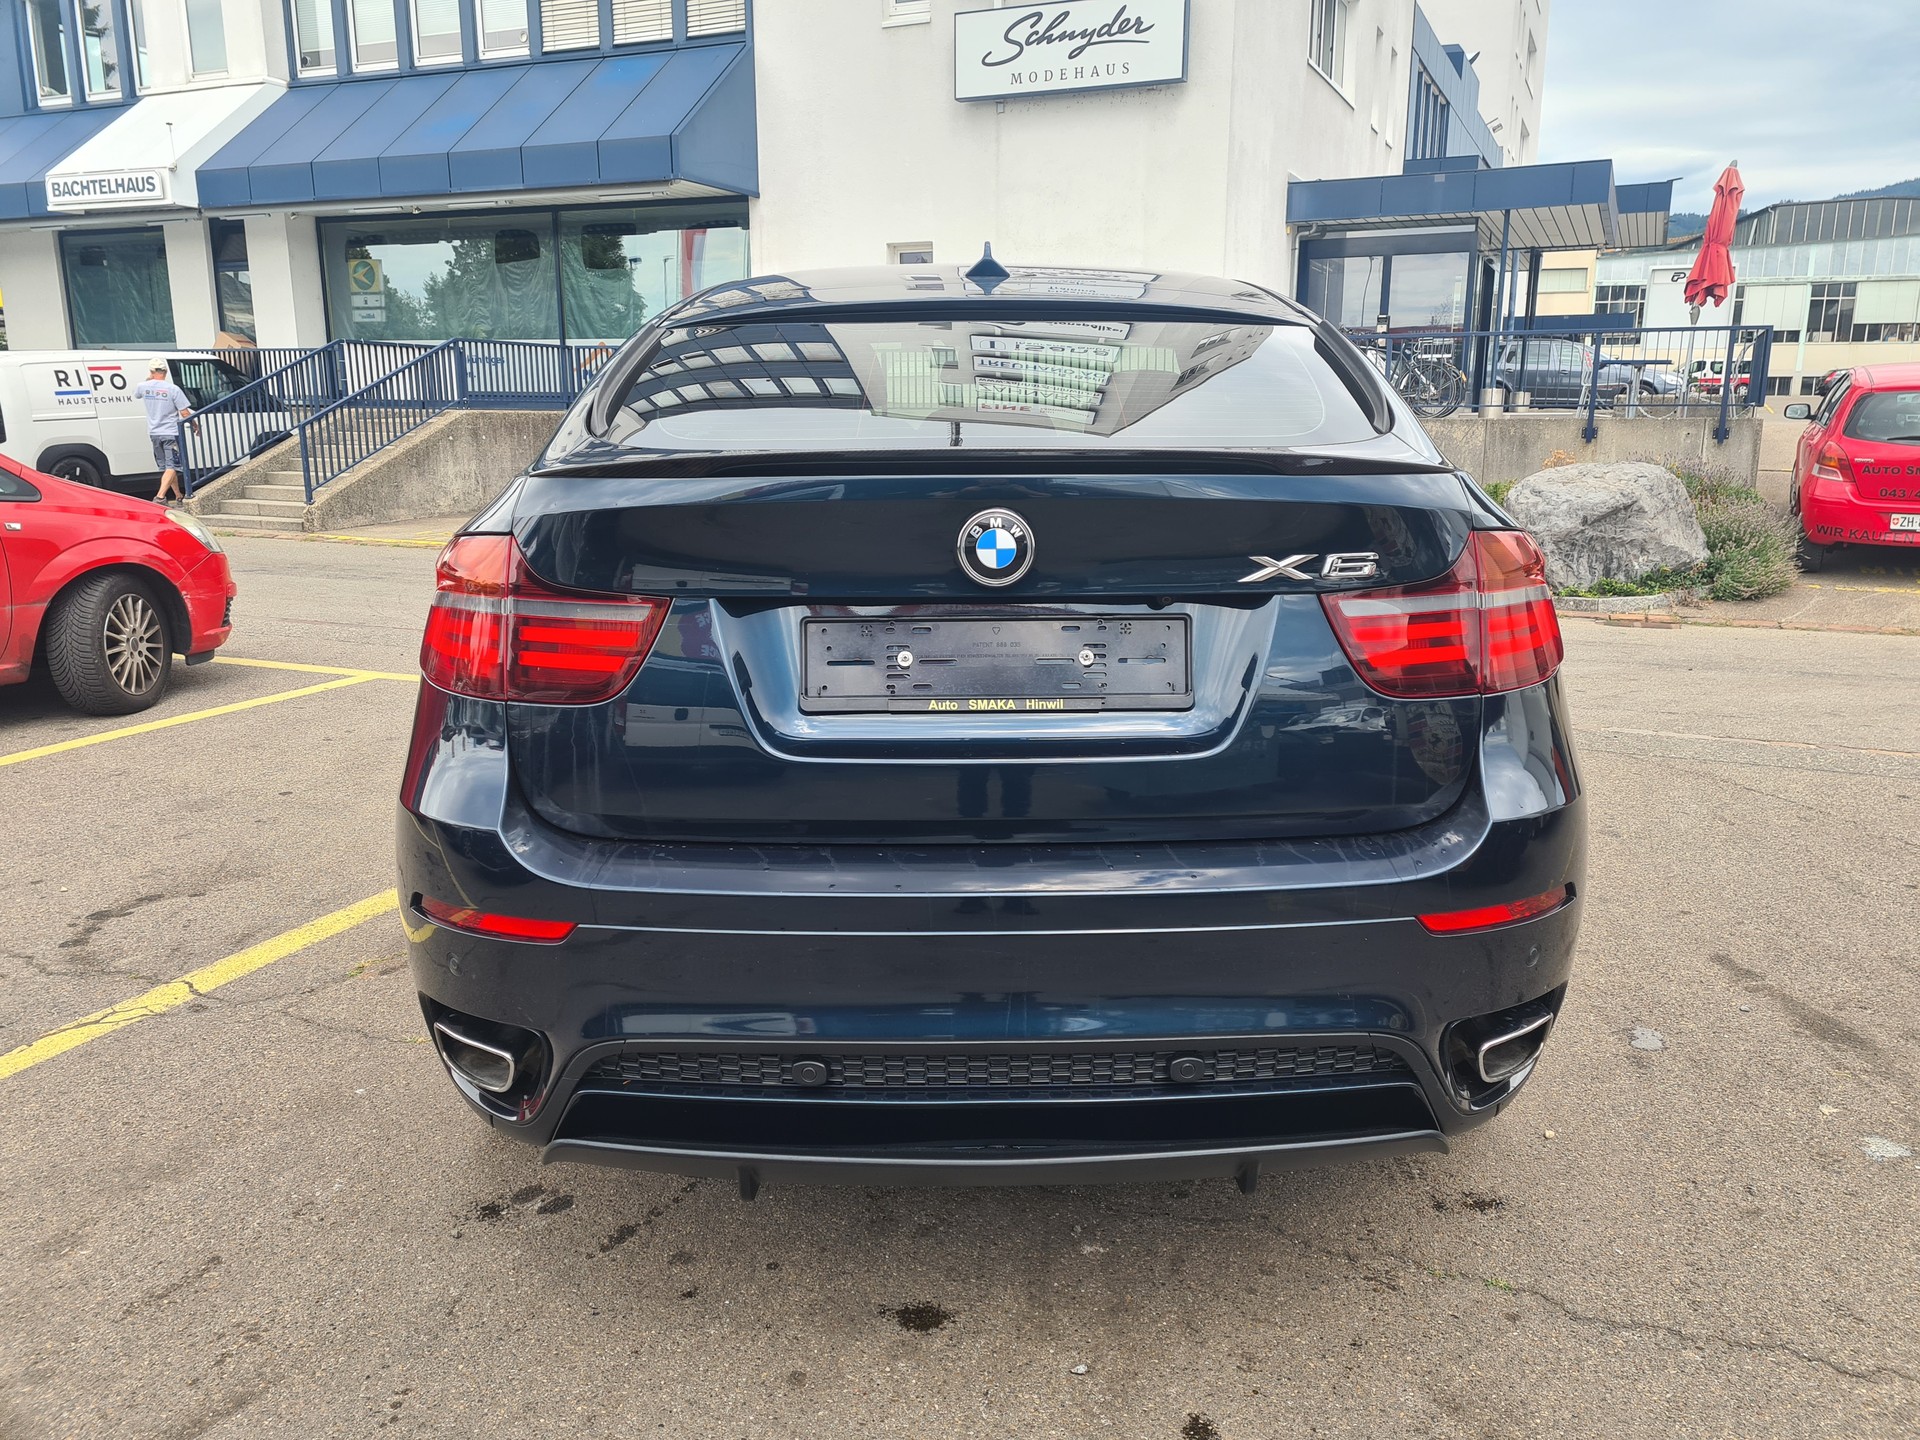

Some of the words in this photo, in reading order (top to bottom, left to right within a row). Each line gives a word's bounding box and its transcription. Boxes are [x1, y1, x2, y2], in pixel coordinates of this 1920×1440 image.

[981, 4, 1156, 67] Schnyder
[1010, 62, 1131, 86] MODEHAUS
[51, 176, 156, 198] BACHTELHAUS
[53, 369, 128, 391] RIPO
[57, 395, 133, 406] HAUSTECHNIK
[1862, 465, 1901, 475] AUTO
[969, 517, 1024, 539] BMW
[1816, 524, 1844, 537] WIR
[1849, 528, 1915, 544] KAUFEN
[1237, 551, 1380, 583] X6
[928, 699, 959, 711] Auto
[968, 699, 1017, 710] SMAKA
[1026, 698, 1065, 710] Hinwil
